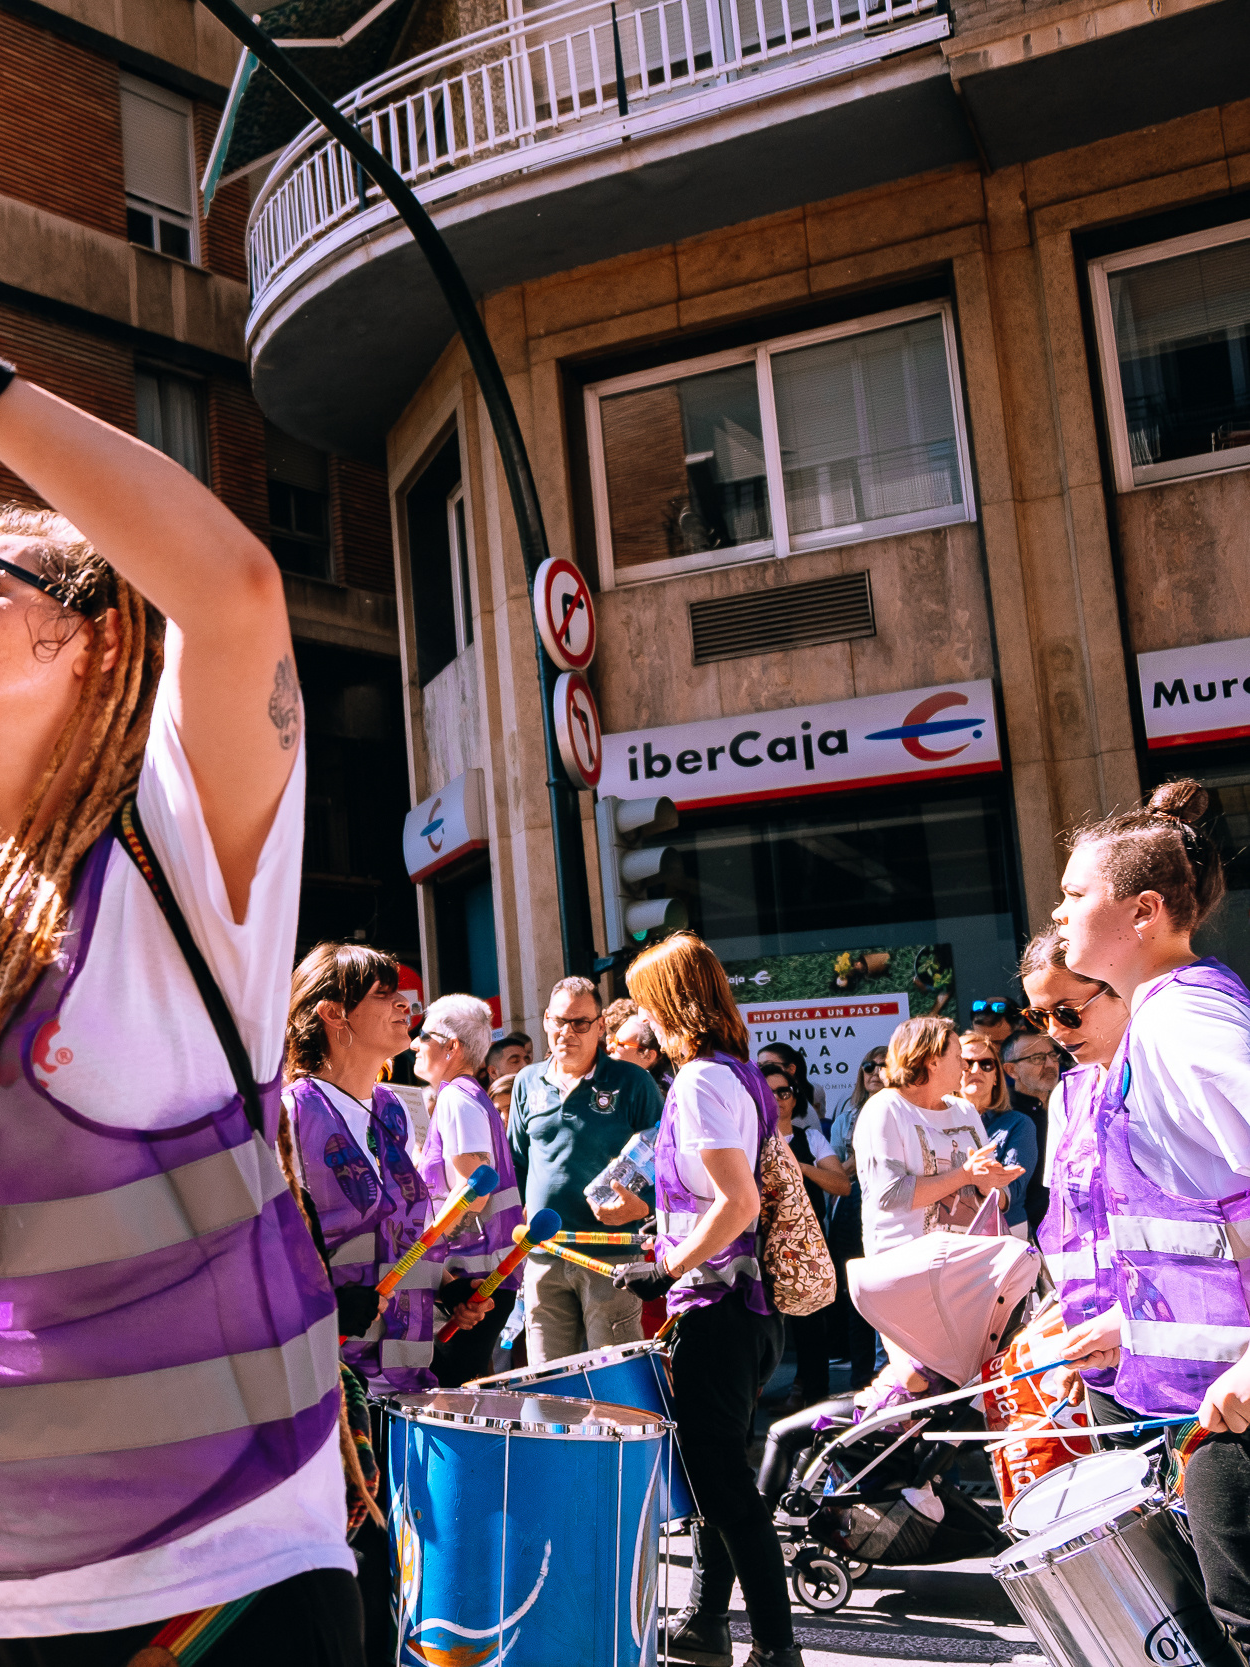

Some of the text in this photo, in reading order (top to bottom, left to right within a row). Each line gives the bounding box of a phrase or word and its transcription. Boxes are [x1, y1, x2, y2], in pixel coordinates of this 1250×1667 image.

[627, 720, 849, 781] iberCaja
[753, 1006, 881, 1022] HIPOTECA A UN PASO
[755, 1025, 856, 1042] TU NUEVA
